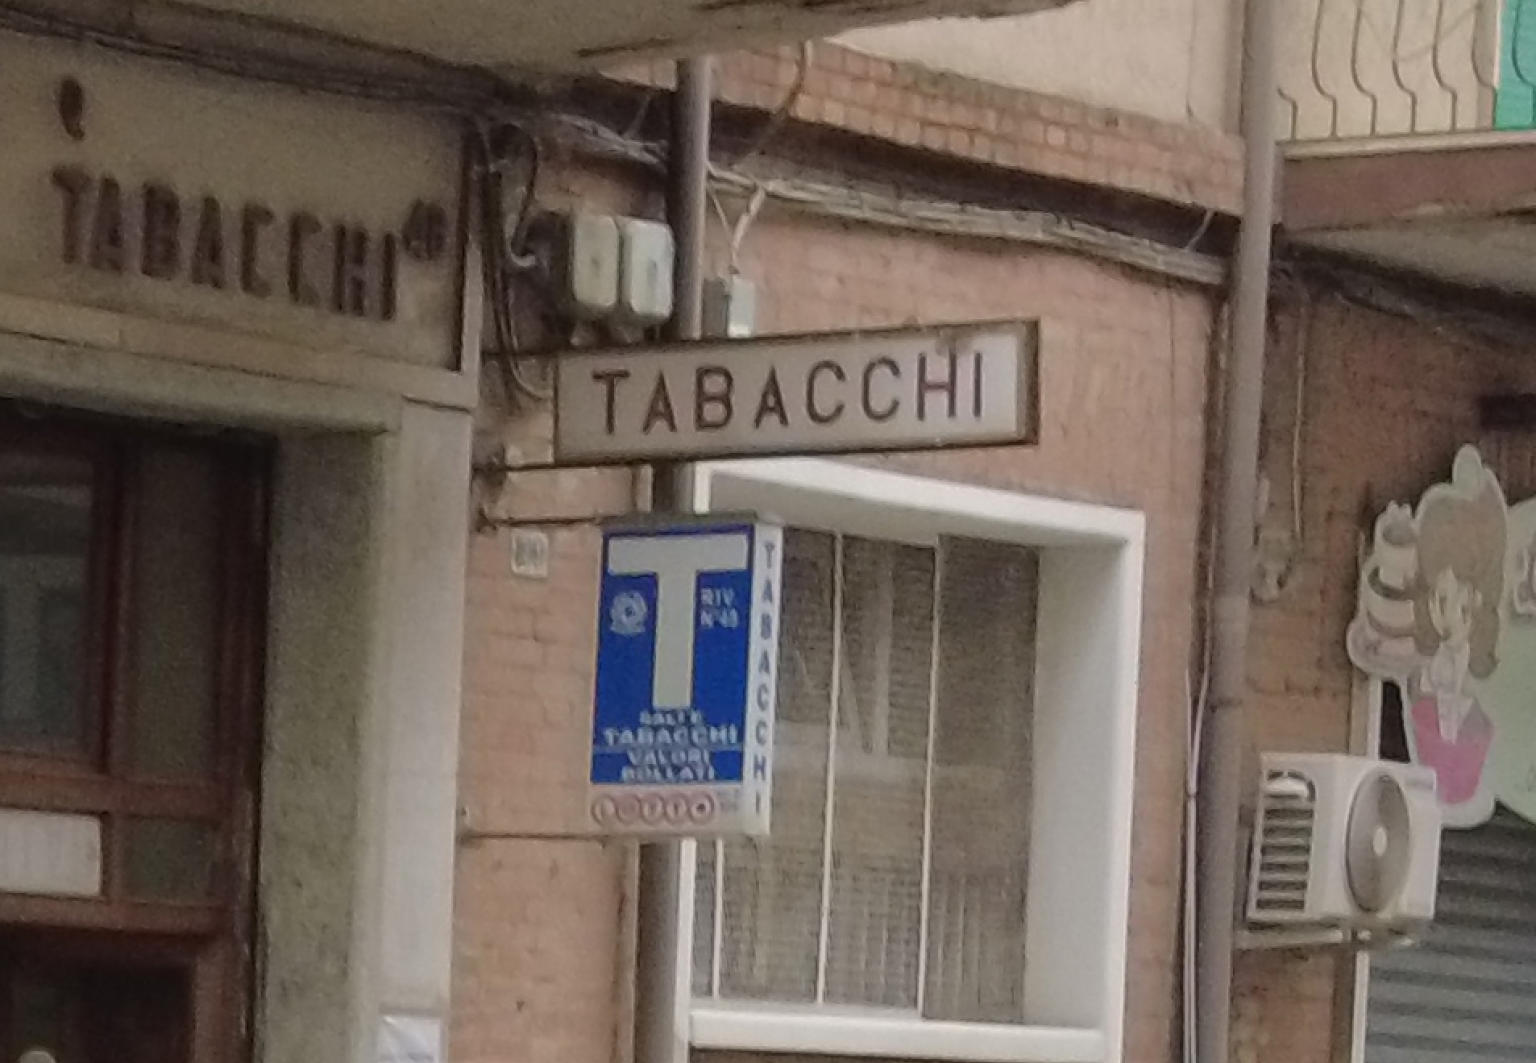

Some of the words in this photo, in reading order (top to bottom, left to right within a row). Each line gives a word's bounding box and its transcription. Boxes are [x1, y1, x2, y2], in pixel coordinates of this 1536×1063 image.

[52, 165, 397, 321] TABACCHI
[593, 351, 984, 434] TABACCHI
[603, 724, 738, 746] TABACCHI
